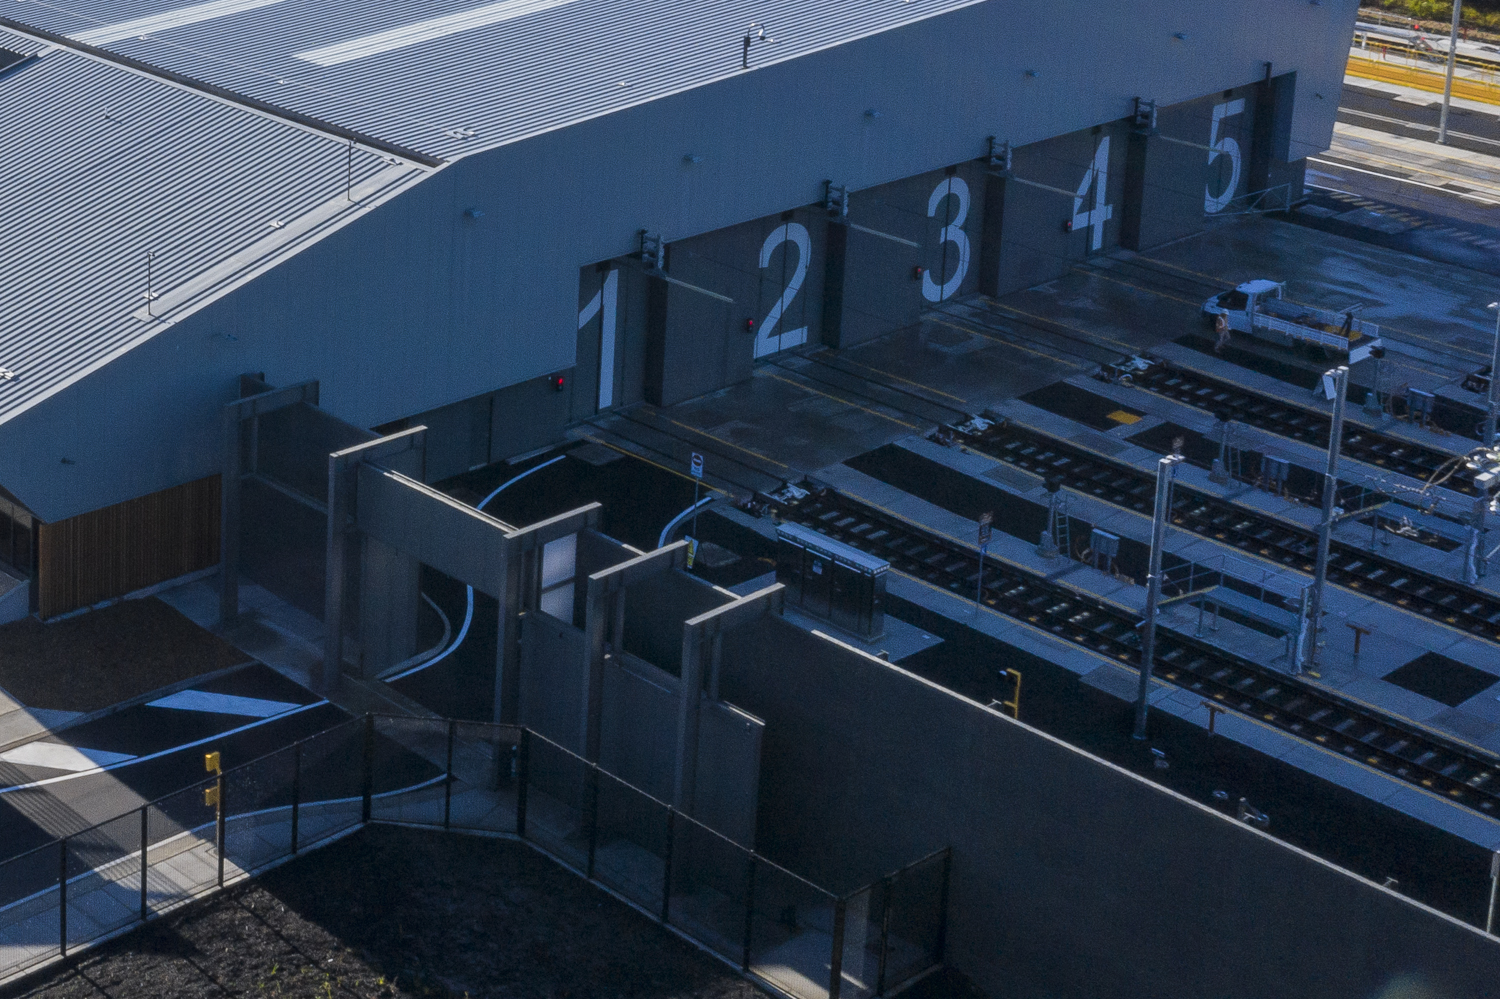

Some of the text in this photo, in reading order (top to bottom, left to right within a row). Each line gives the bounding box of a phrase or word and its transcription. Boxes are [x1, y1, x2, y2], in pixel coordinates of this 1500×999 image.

[1073, 136, 1113, 250] 4
[1204, 99, 1244, 213] 5
[753, 222, 811, 358] 2
[922, 177, 970, 302] 3
[579, 269, 618, 408] 1
